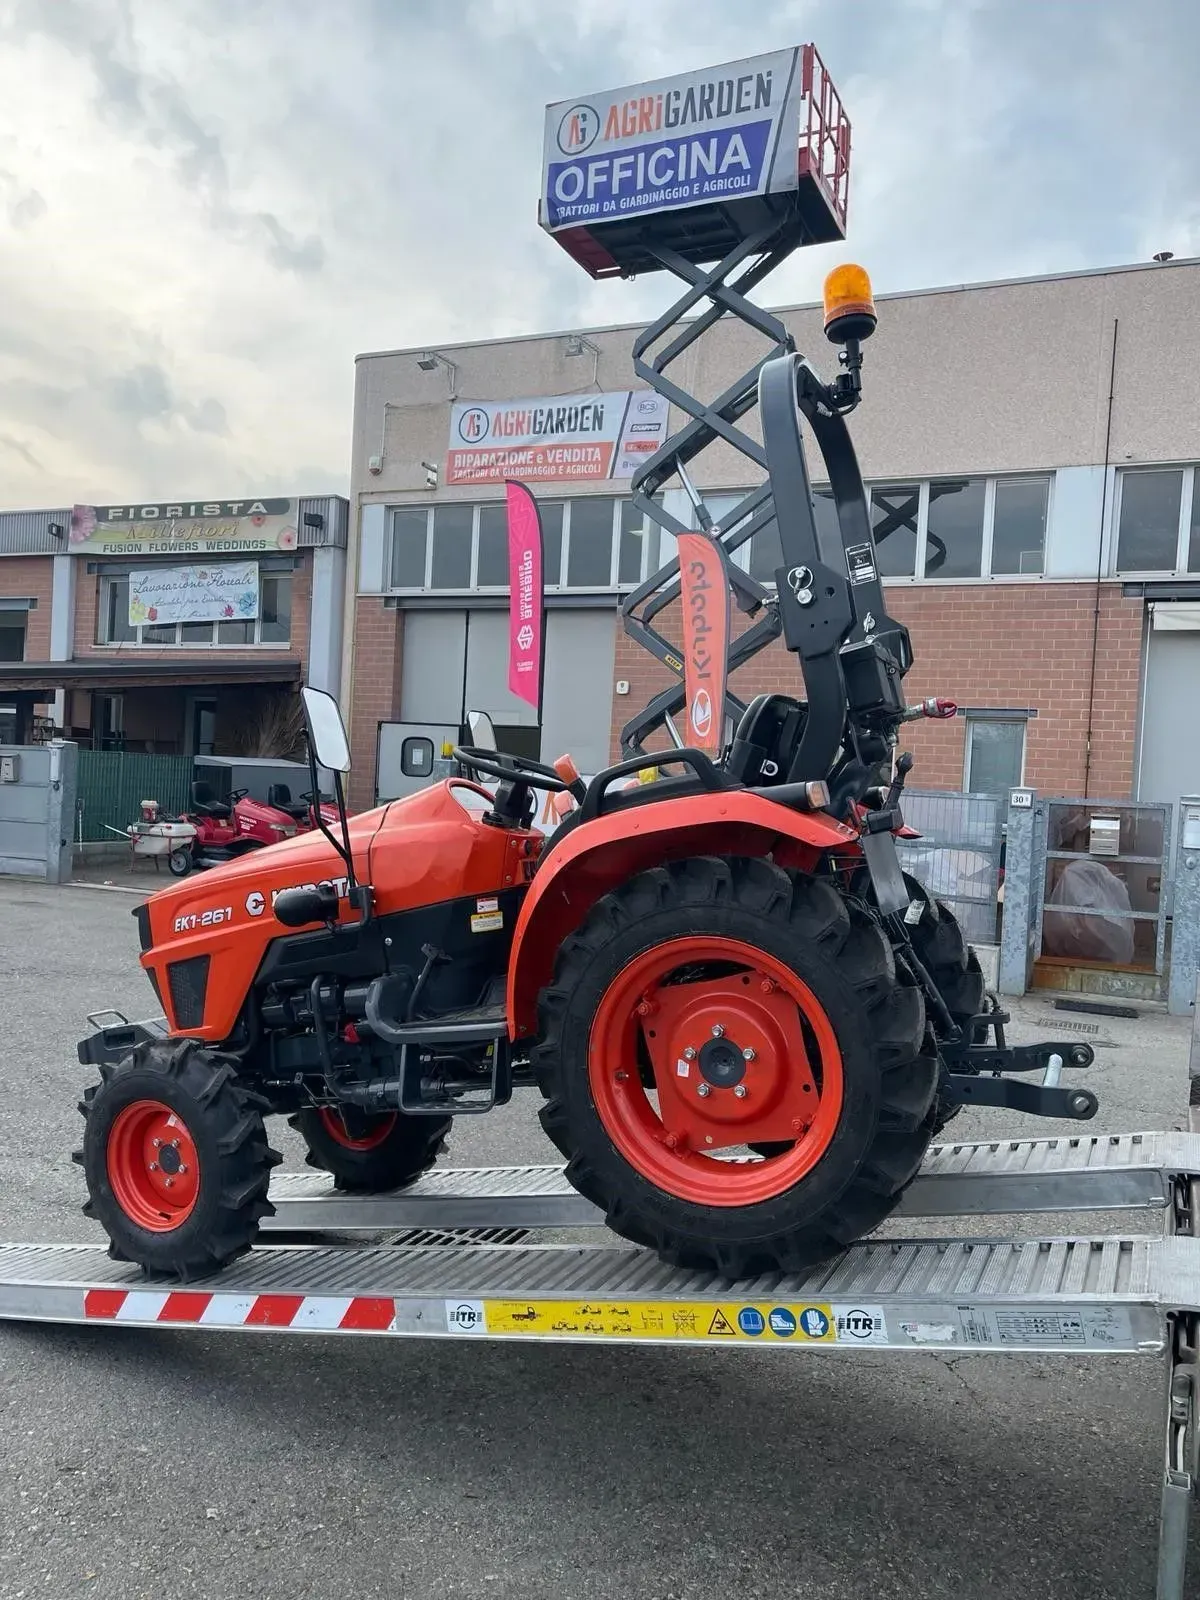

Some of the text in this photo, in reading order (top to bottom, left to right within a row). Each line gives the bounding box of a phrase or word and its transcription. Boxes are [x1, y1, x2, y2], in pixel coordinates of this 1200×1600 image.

[555, 133, 751, 203] OFFICINA
[556, 174, 751, 219] TRATTORI DA GIARDINAGGIO E AGRICOLI
[454, 447, 601, 468] RIPARAZIONE e VENDITA
[454, 463, 601, 479] TRATTORI DA GIARDINAGGIO E AGRICOLI
[108, 502, 268, 520] FIORISTA
[103, 539, 267, 553] FUSION FLOWERS WEDDINGS
[667, 656, 681, 668] KEEP
[1013, 796, 1024, 804] 30
[174, 907, 232, 933] EK1-261
[456, 1311, 477, 1322] ITR
[846, 1317, 873, 1330] ITR
